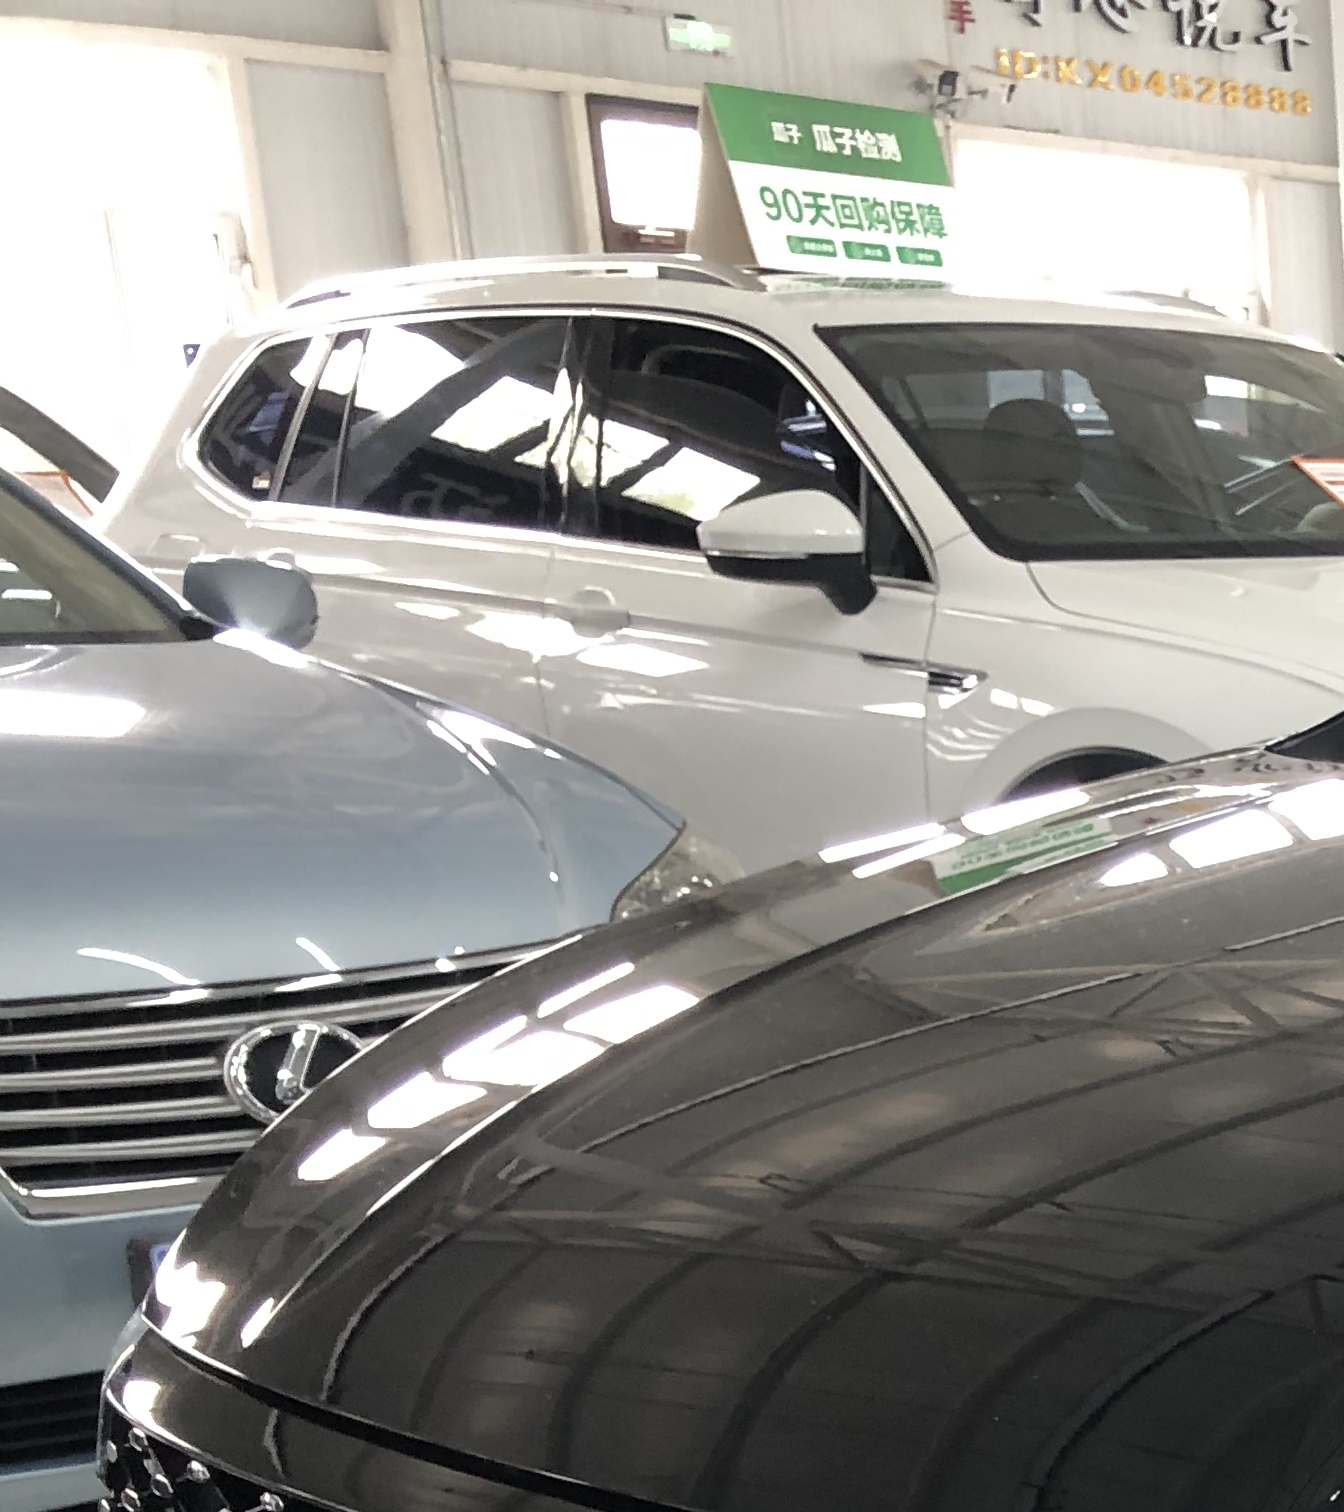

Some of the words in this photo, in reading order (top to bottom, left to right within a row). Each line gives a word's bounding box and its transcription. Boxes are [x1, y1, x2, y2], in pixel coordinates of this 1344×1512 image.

[811, 124, 902, 163] 瓜子检测
[758, 186, 948, 239] 90天回购保障
